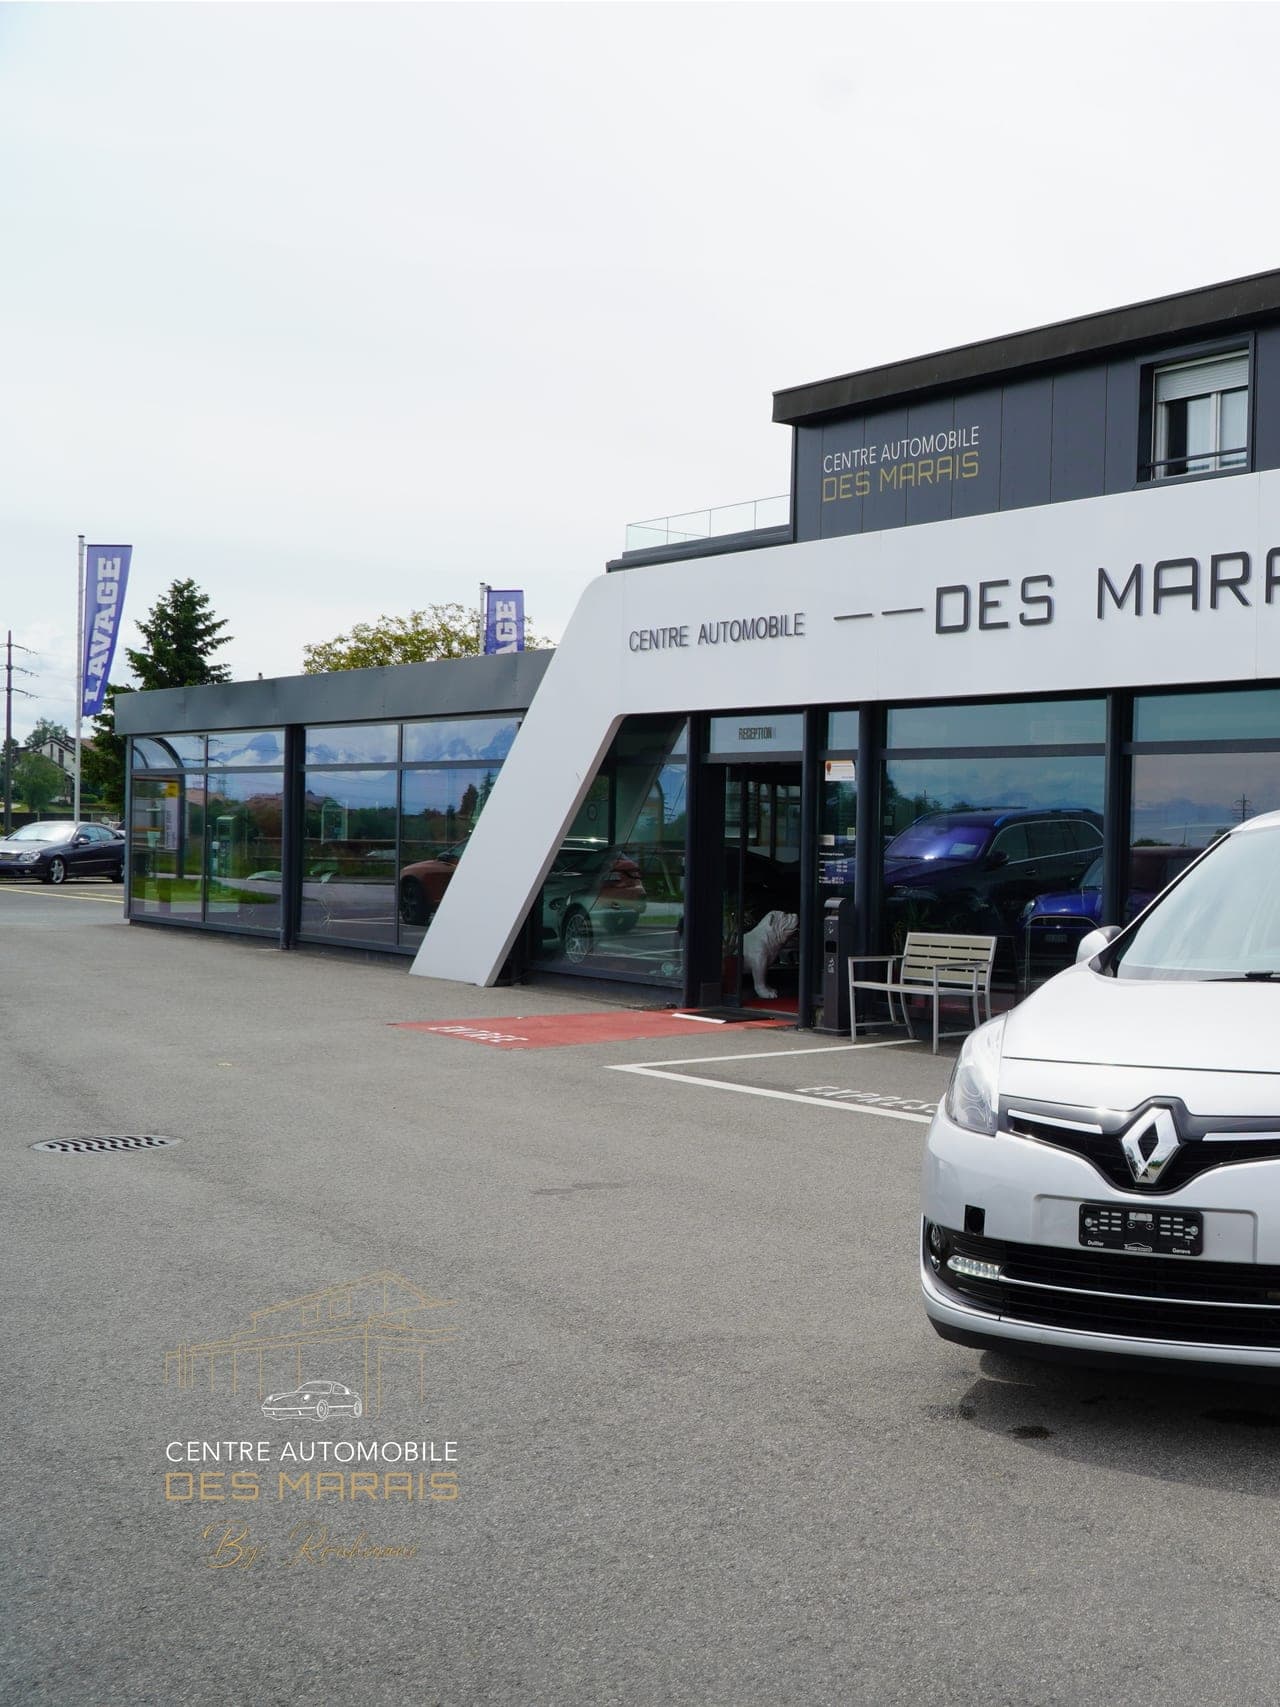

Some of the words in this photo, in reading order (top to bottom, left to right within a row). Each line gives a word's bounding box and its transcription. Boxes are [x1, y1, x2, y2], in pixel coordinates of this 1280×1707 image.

[822, 470, 871, 502] DES
[879, 451, 980, 493] MARAIS
[823, 446, 877, 473] CENTRE
[880, 425, 980, 463] AUTOMOBILE
[84, 557, 121, 702] LAVAGE
[629, 625, 689, 652] CENTRE
[697, 612, 806, 645] AUTOMOBILE
[935, 573, 1055, 635] DES
